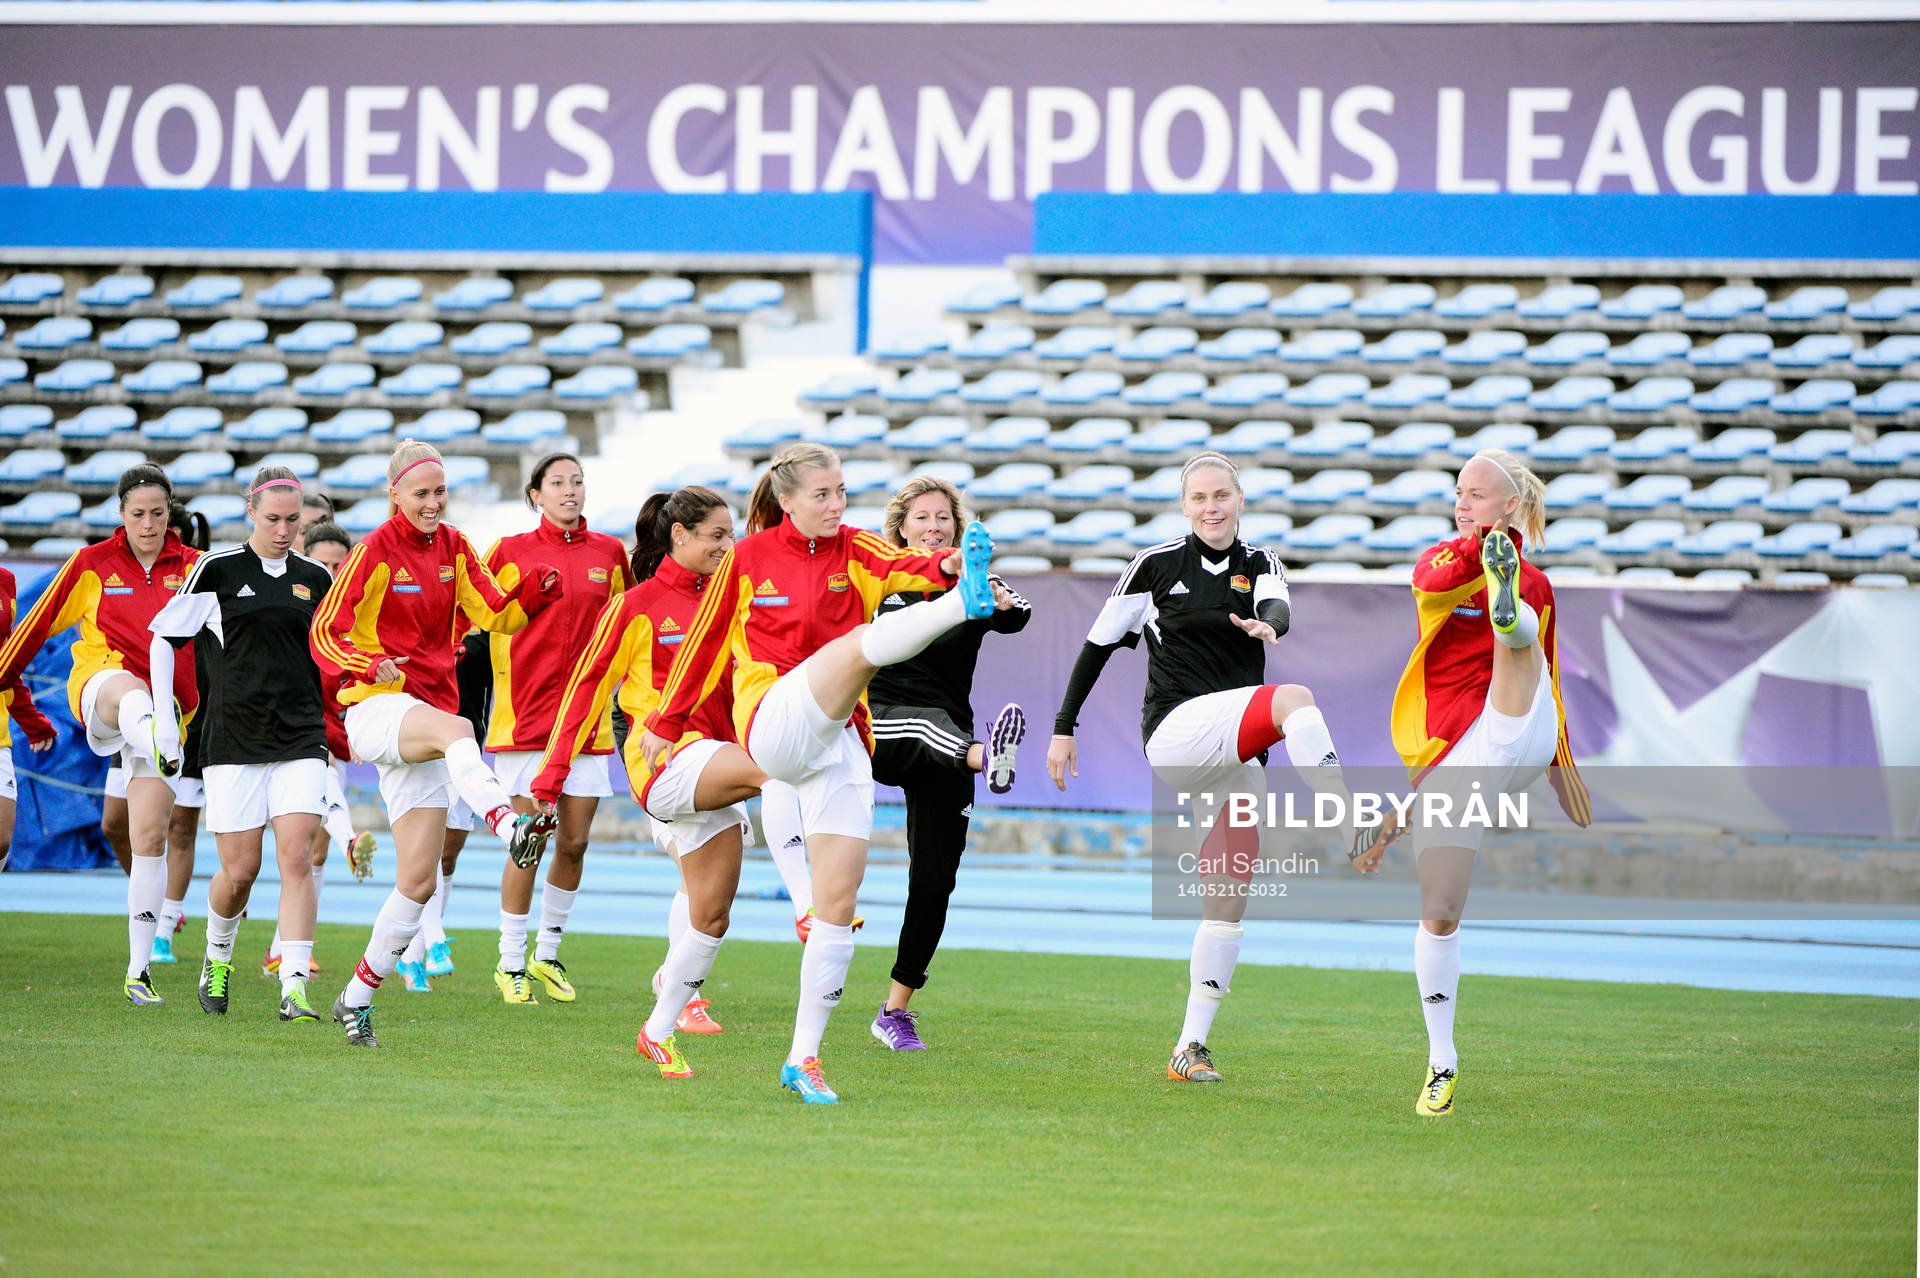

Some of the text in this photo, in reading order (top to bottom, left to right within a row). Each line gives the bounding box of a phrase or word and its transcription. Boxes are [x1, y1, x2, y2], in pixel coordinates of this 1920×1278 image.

[4, 83, 1919, 200] WOMEN'S CHAMPIONS LEAGUE
